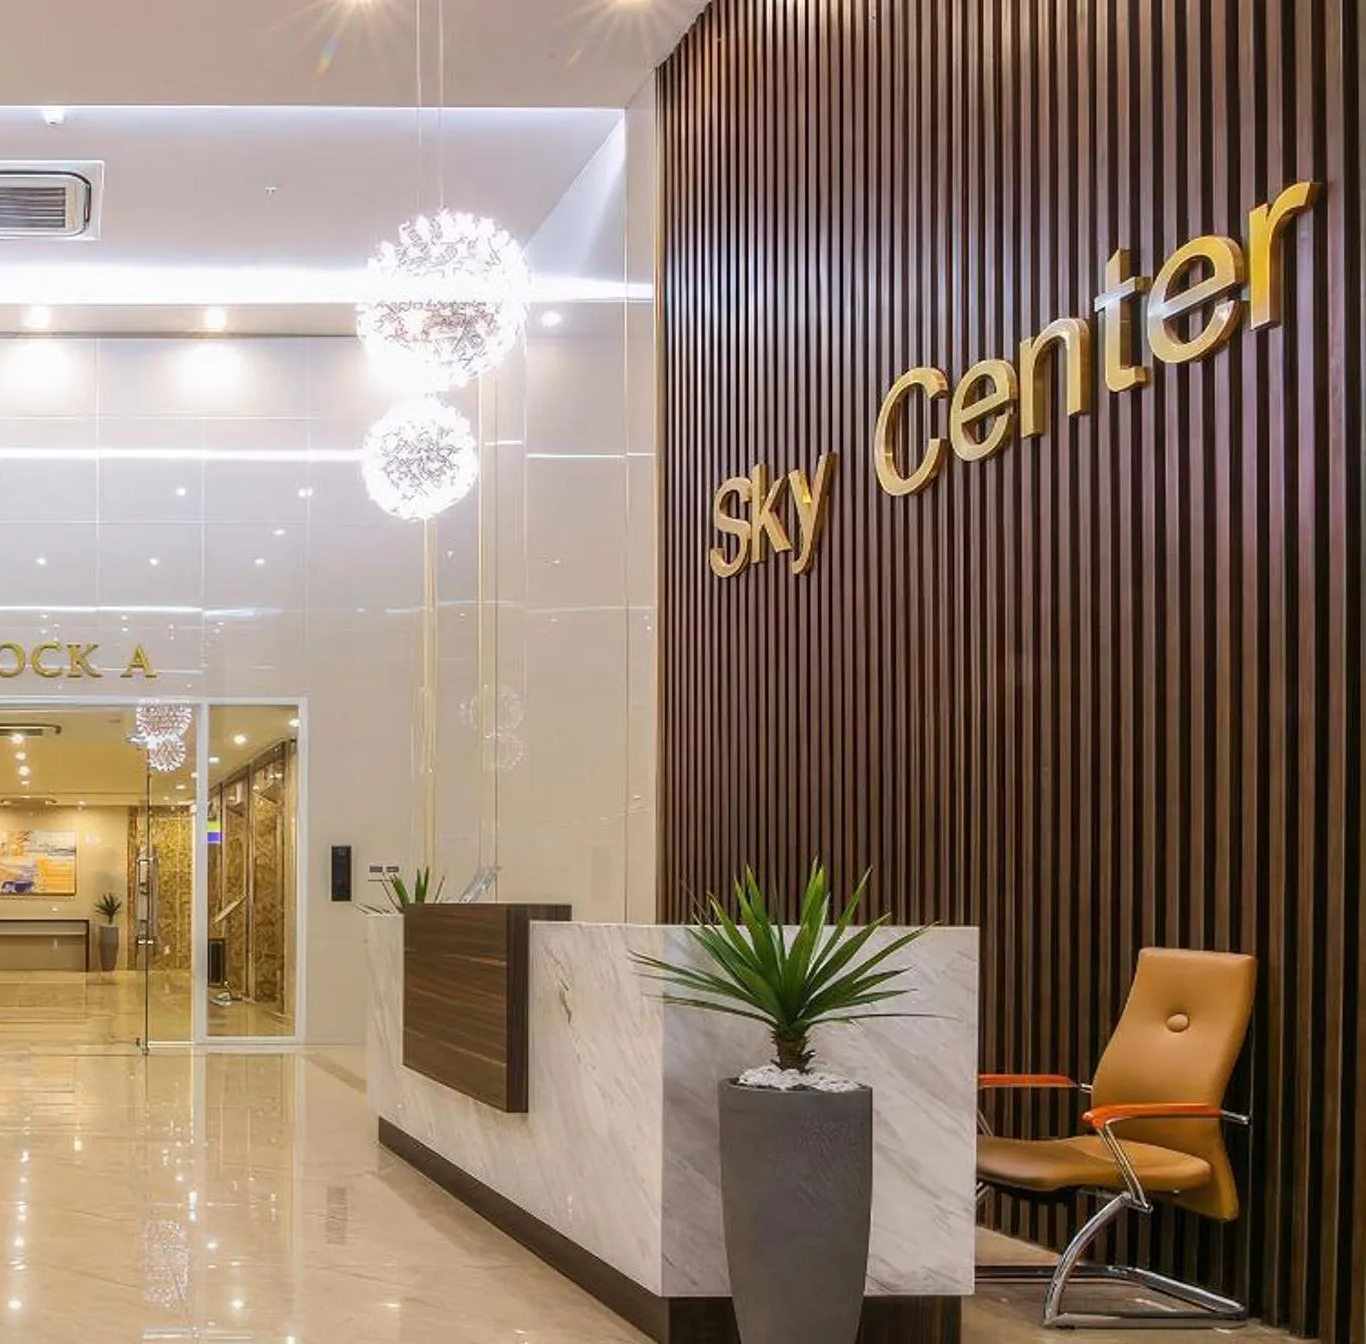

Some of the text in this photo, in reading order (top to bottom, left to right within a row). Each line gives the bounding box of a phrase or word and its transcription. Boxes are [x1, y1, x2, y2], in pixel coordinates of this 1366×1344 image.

[710, 181, 1319, 578] Sky Center
[120, 643, 157, 678] A
